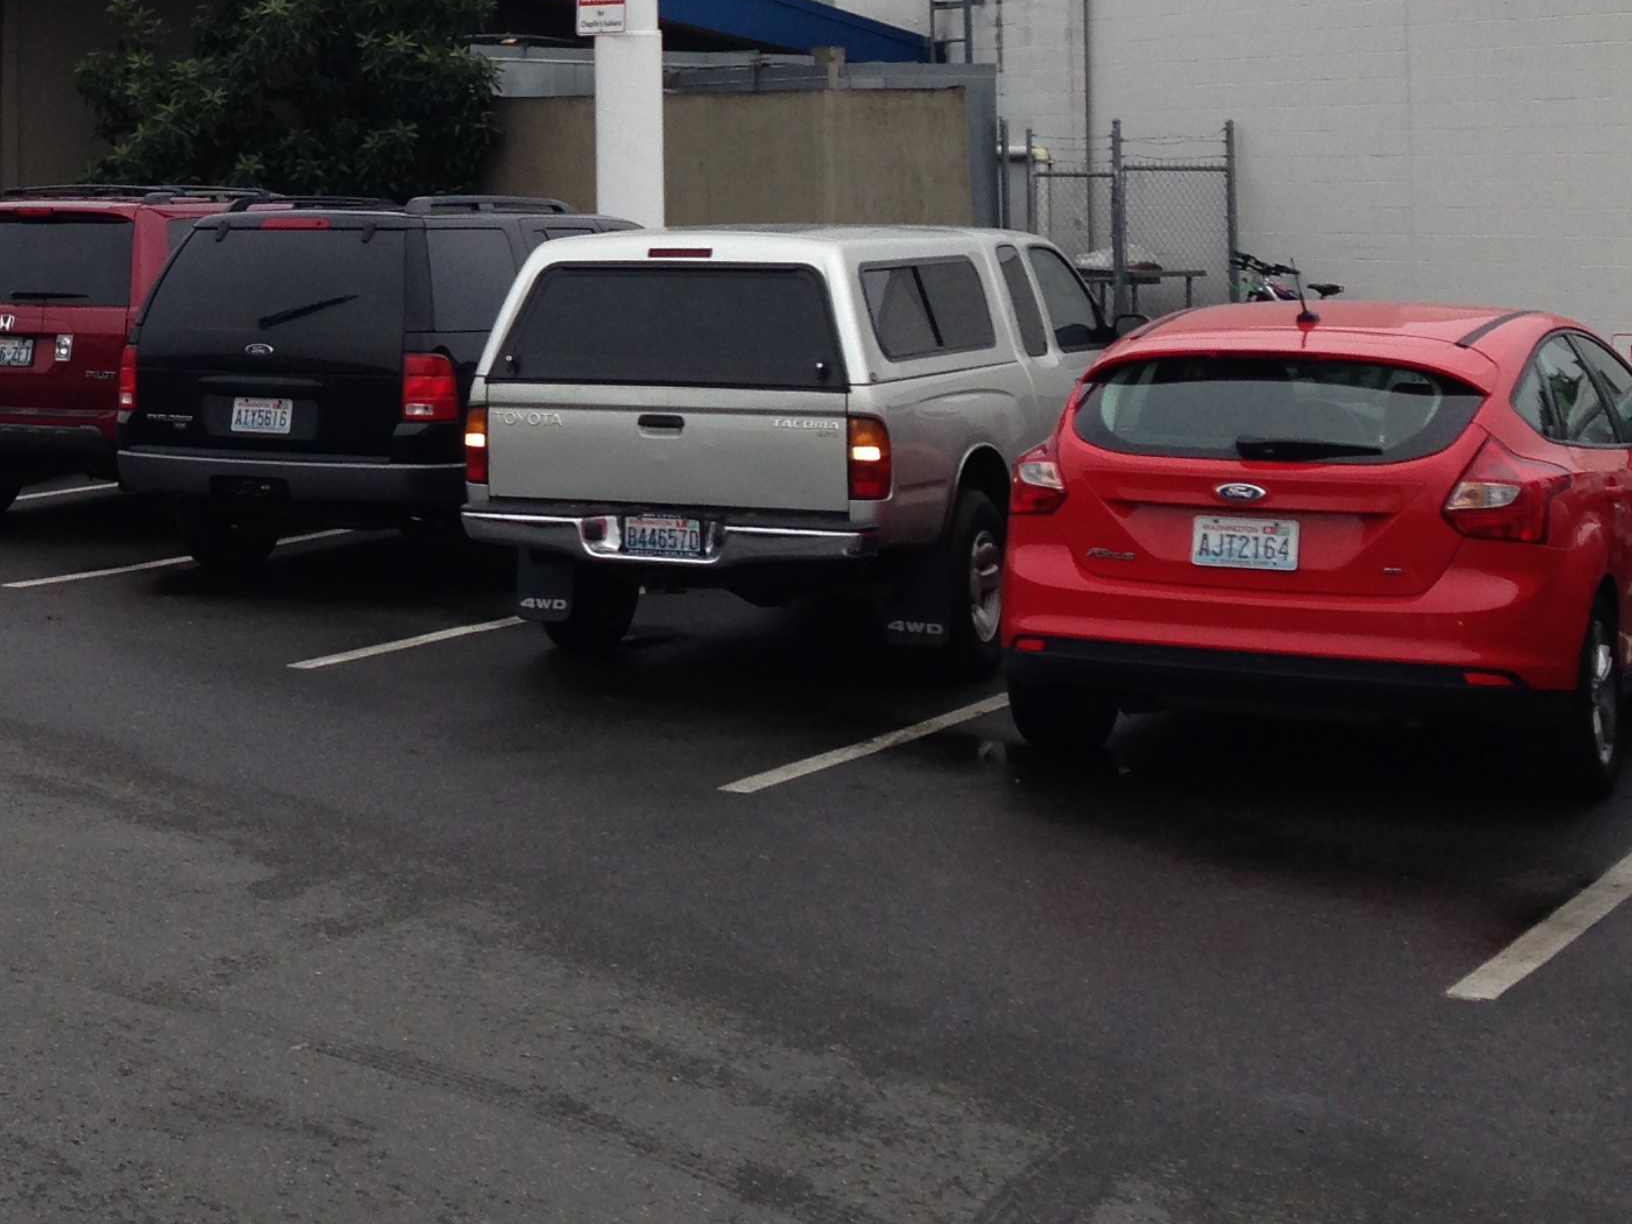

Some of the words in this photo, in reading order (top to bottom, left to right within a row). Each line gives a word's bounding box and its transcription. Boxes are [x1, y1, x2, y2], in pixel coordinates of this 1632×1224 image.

[492, 411, 563, 427] TOYOTA
[1198, 533, 1289, 561] AJT2164
[520, 597, 567, 610] 4WD
[887, 620, 944, 634] 4WD
